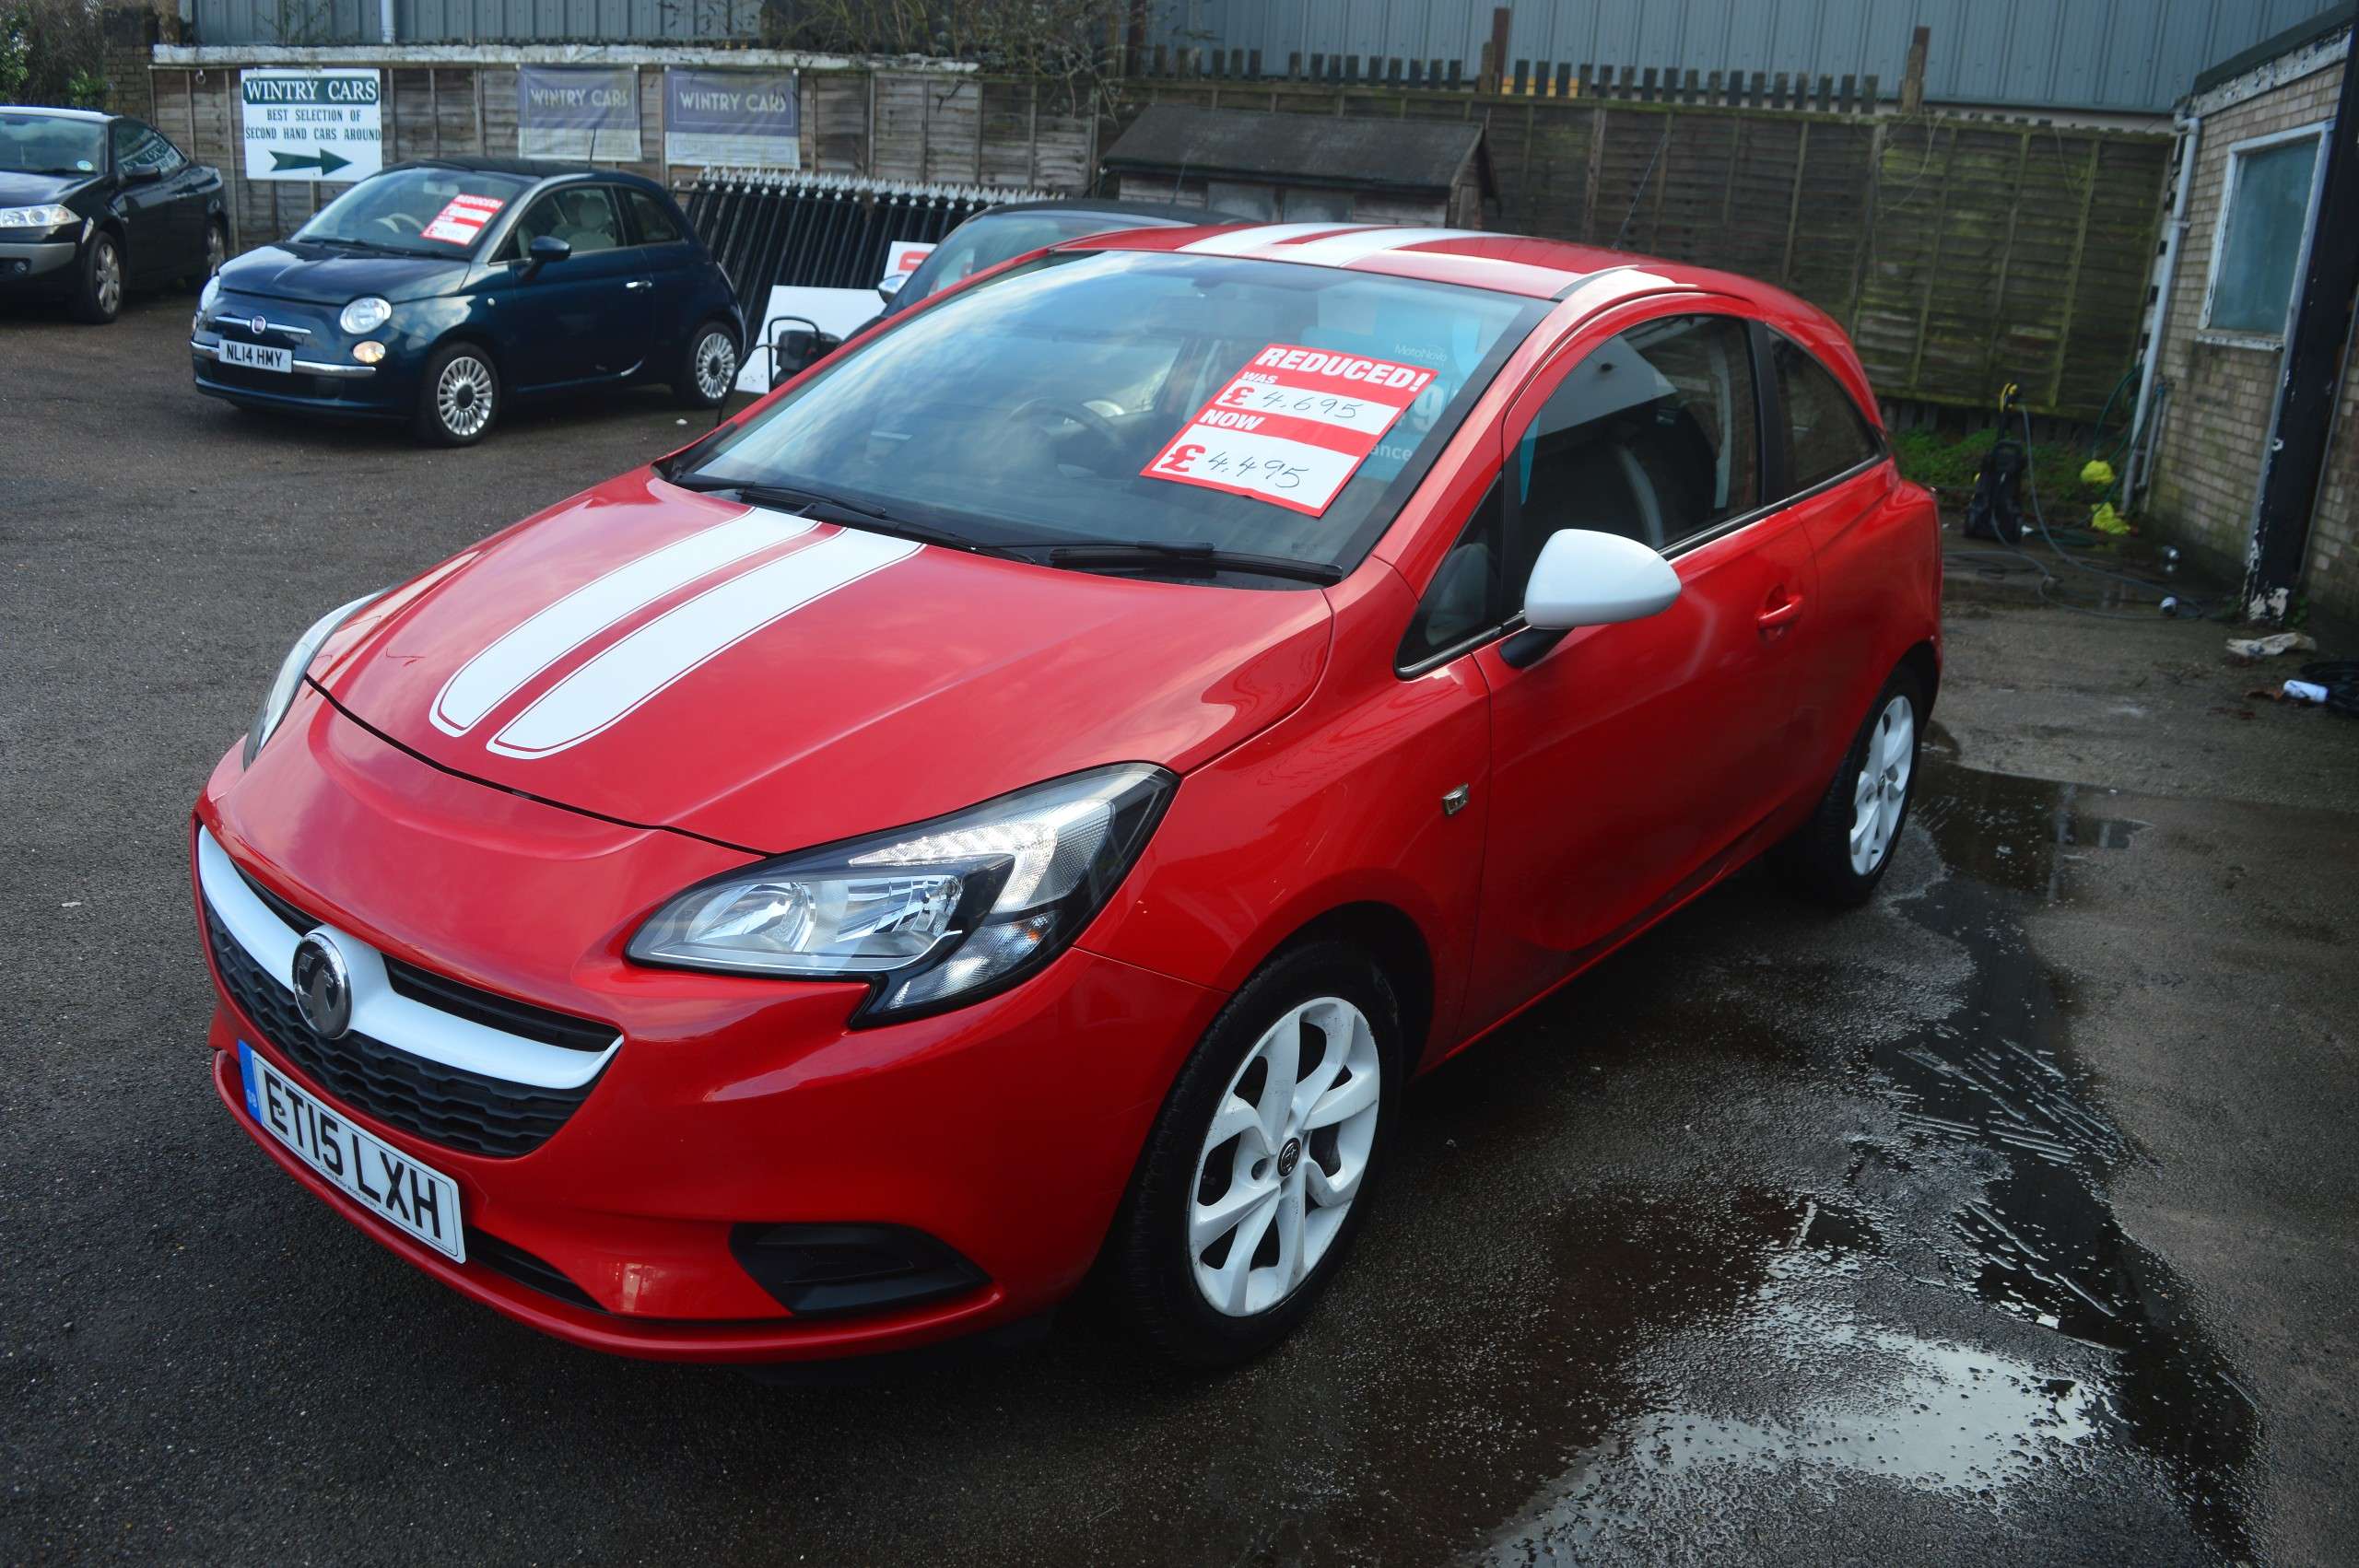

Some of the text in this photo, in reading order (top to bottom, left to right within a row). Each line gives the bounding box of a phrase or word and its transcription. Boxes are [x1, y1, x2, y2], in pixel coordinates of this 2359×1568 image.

[245, 80, 377, 100] WINTRY CARS
[530, 88, 628, 107] WINTRY CARS
[679, 91, 787, 111] WINTRY CARS
[266, 109, 361, 122] BEST SELECTION OF
[245, 126, 381, 141] SECOND HAND CARS AROUND
[227, 344, 283, 369] NL14 HMY
[1241, 371, 1279, 384] WAS
[1255, 347, 1430, 392] REDUCED!
[1198, 408, 1266, 430] NOW
[264, 1069, 442, 1240] ET15 LXH
